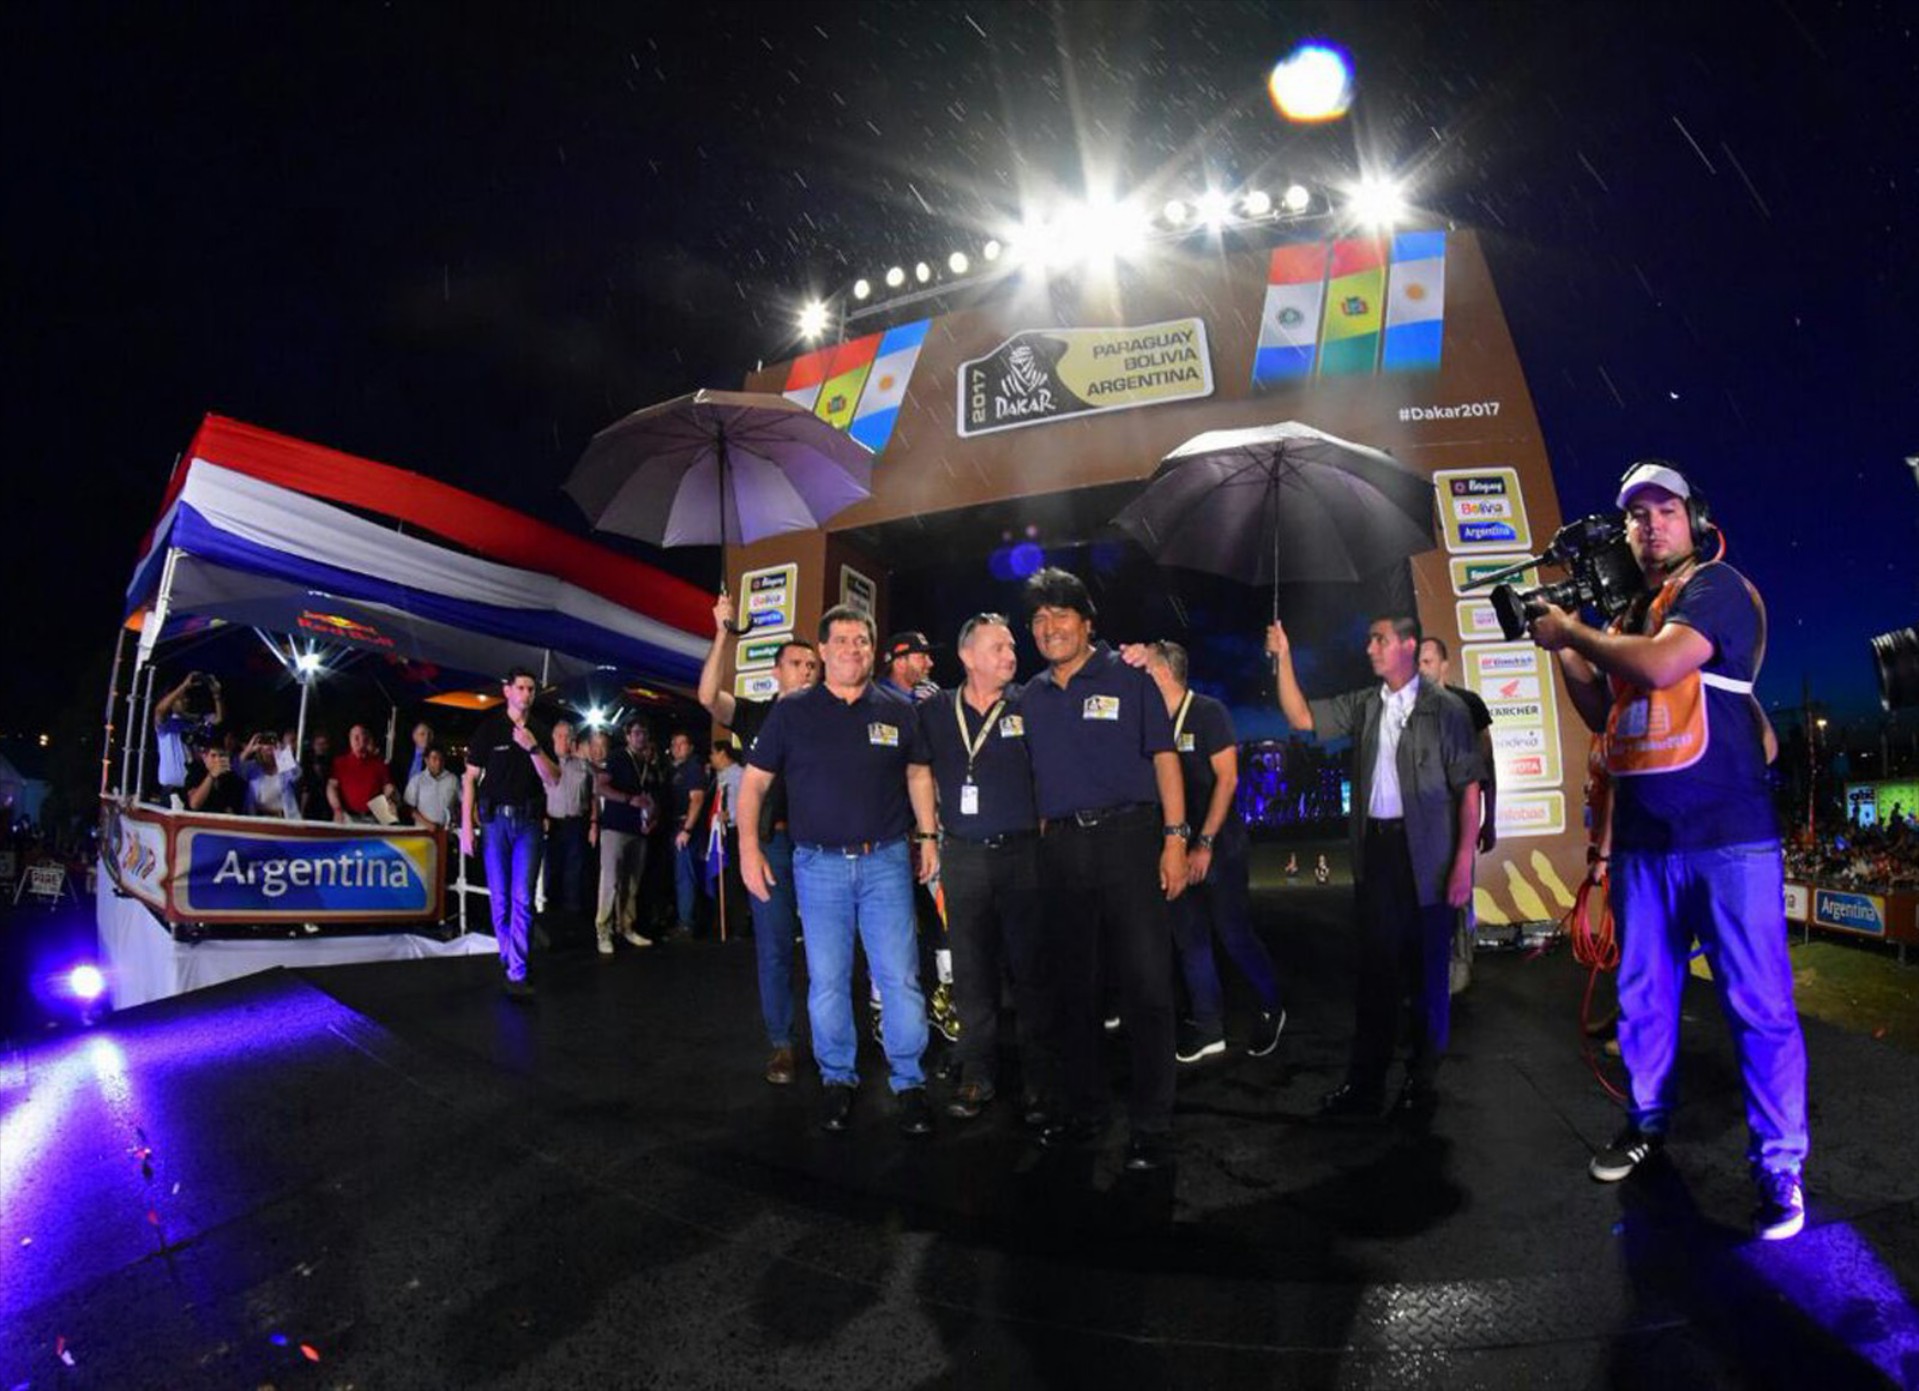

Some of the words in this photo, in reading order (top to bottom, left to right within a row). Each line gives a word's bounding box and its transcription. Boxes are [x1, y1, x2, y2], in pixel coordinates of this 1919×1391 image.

[1092, 329, 1195, 359] PARAGUAY
[1124, 347, 1198, 371] BOLIVIA
[1086, 365, 1200, 397] ARGENTINA
[972, 369, 986, 423] 2017
[1399, 402, 1500, 421] #Dakar2017
[1464, 526, 1511, 540] Argentina
[213, 850, 409, 897] Argentina
[1821, 896, 1876, 921] Argentina
